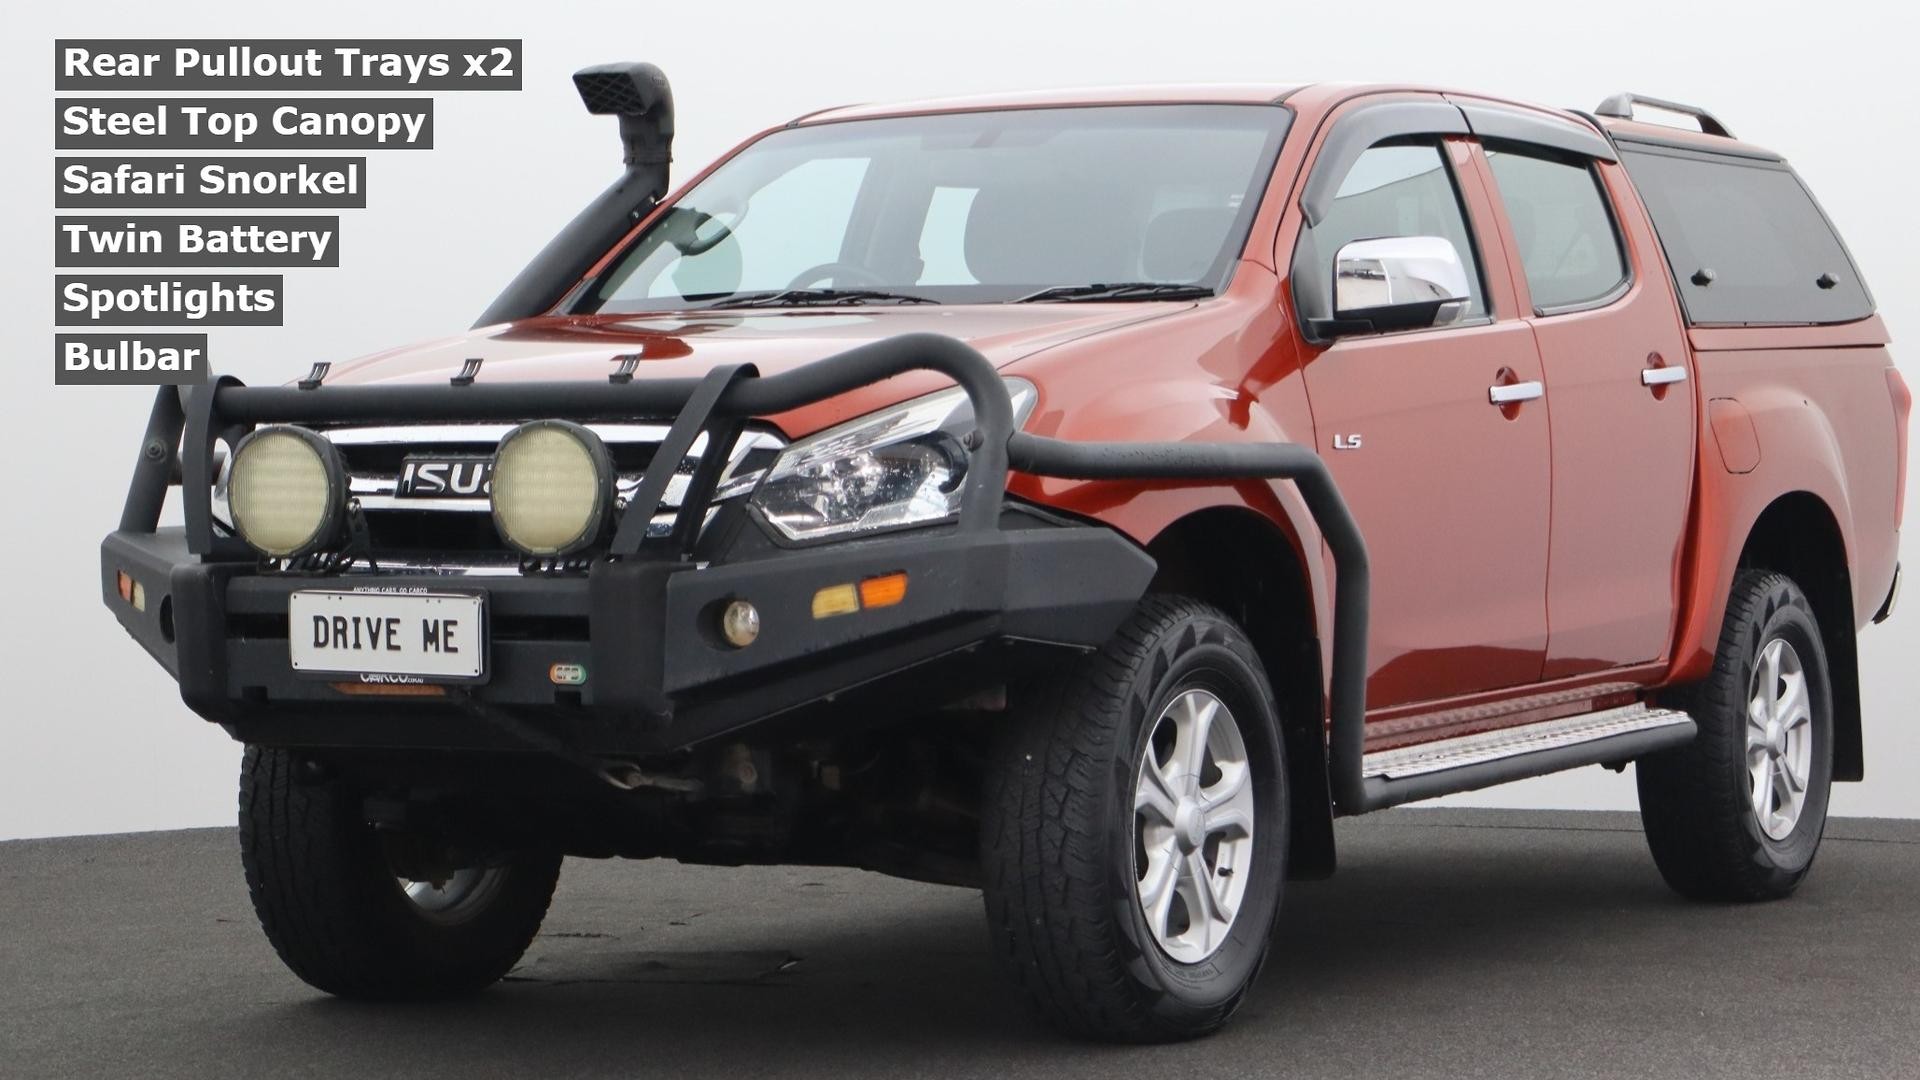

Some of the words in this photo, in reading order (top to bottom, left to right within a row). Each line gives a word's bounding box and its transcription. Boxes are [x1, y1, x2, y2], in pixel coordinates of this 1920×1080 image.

[1333, 434, 1362, 449] LS
[402, 463, 493, 494] ISU
[313, 615, 402, 650] DRIVE
[422, 618, 459, 653] ME
